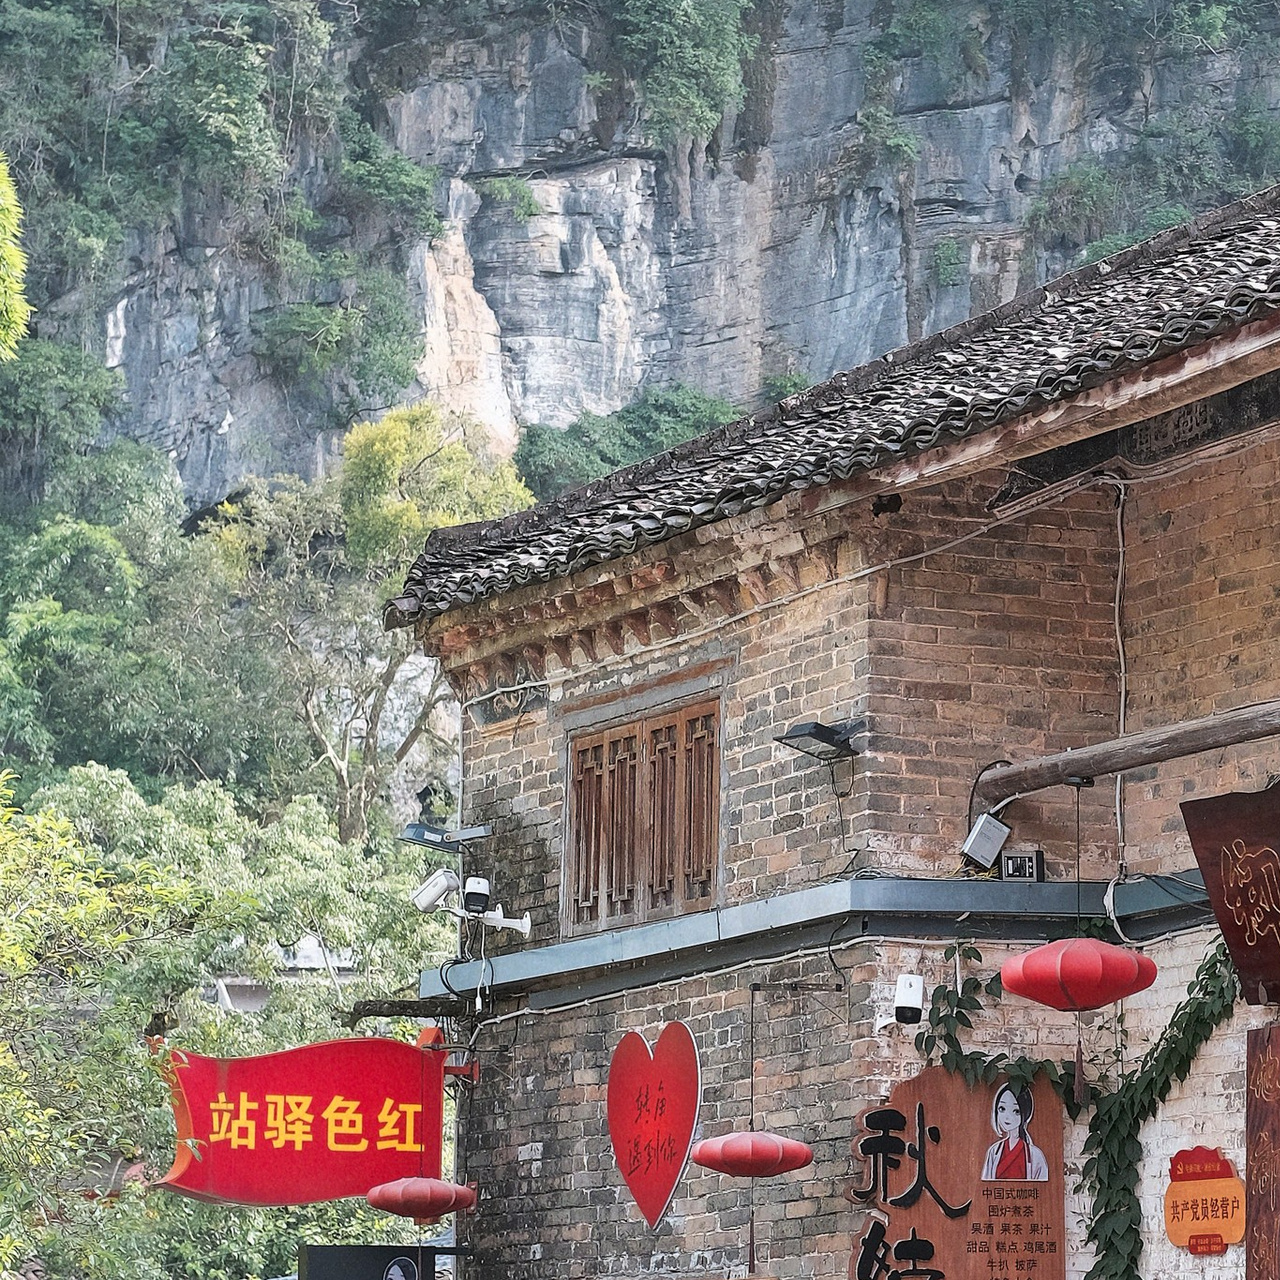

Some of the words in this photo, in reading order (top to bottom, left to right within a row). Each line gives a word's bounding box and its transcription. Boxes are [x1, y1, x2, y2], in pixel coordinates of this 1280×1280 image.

[982, 1187, 1040, 1200] 中国式咖啡
[988, 1205, 1035, 1218] 围炉煮茶
[1171, 1196, 1240, 1223] 共产党员经营户
[971, 1222, 995, 1235] 果酒
[1000, 1223, 1023, 1236] 果茶
[1029, 1223, 1053, 1236] 果汁
[966, 1241, 990, 1254] 甜品
[995, 1241, 1019, 1254] 糕点
[1023, 1241, 1057, 1254] 鸡尾酒
[986, 1258, 1010, 1272] 牛扒
[1015, 1259, 1038, 1272] 披萨
